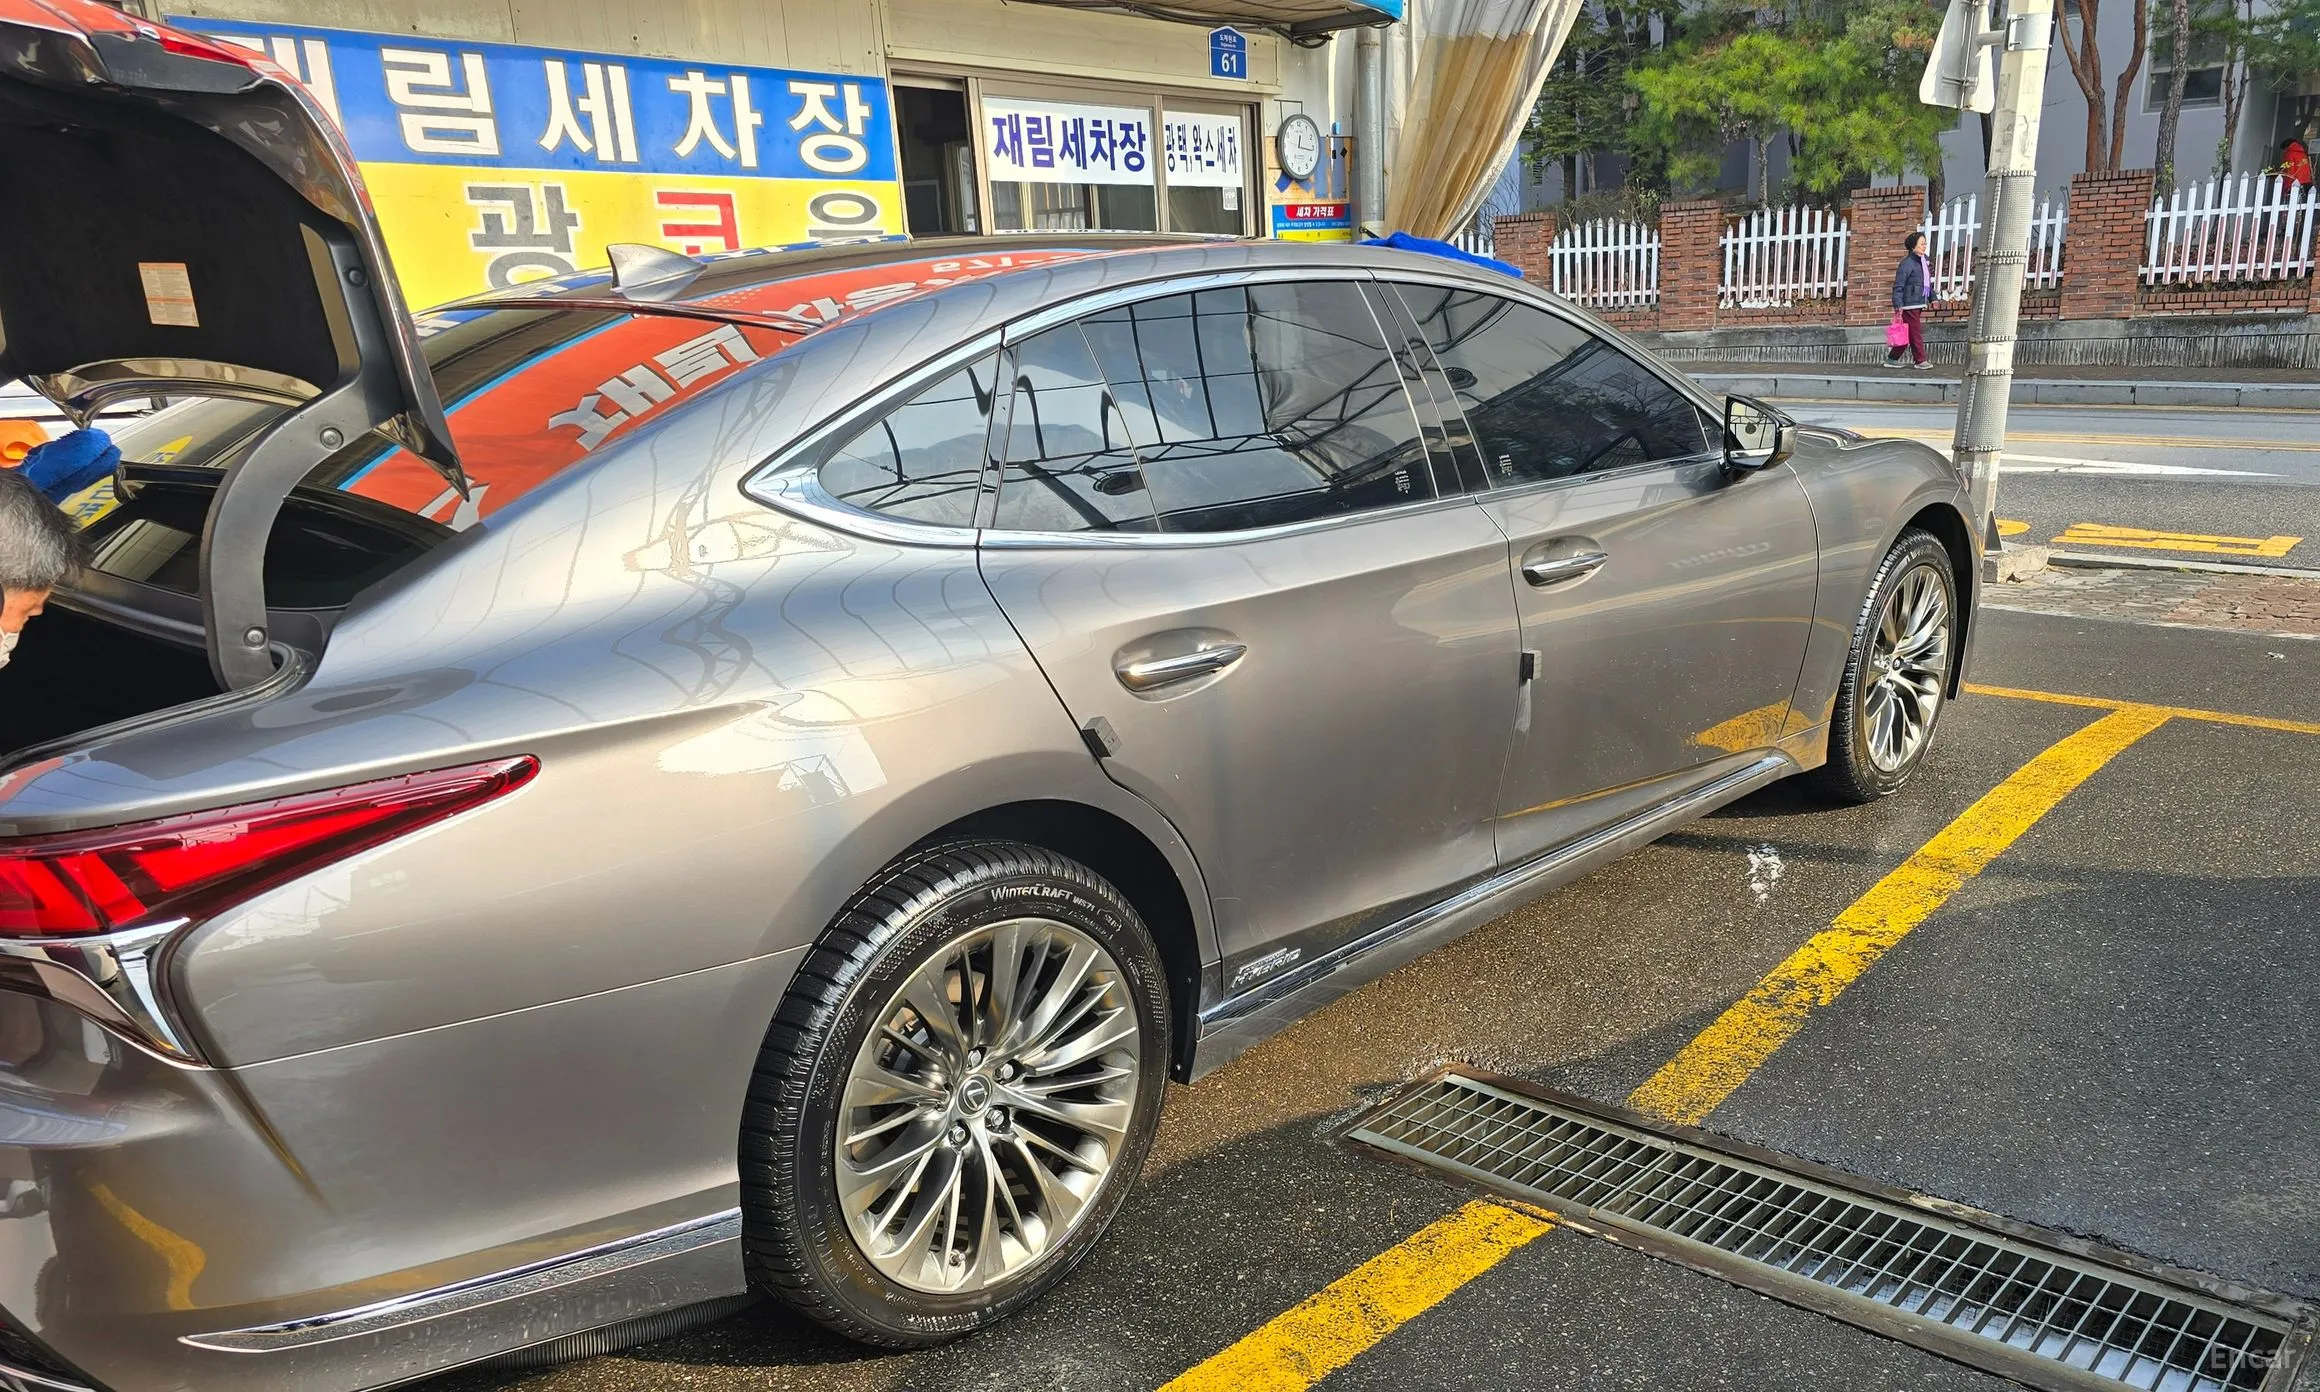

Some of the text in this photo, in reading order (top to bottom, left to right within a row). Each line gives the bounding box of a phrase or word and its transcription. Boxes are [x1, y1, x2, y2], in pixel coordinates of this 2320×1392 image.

[1221, 53, 1237, 73] 61
[992, 113, 1146, 172] 재림세차장
[1296, 206, 1335, 217] 세차 가격표
